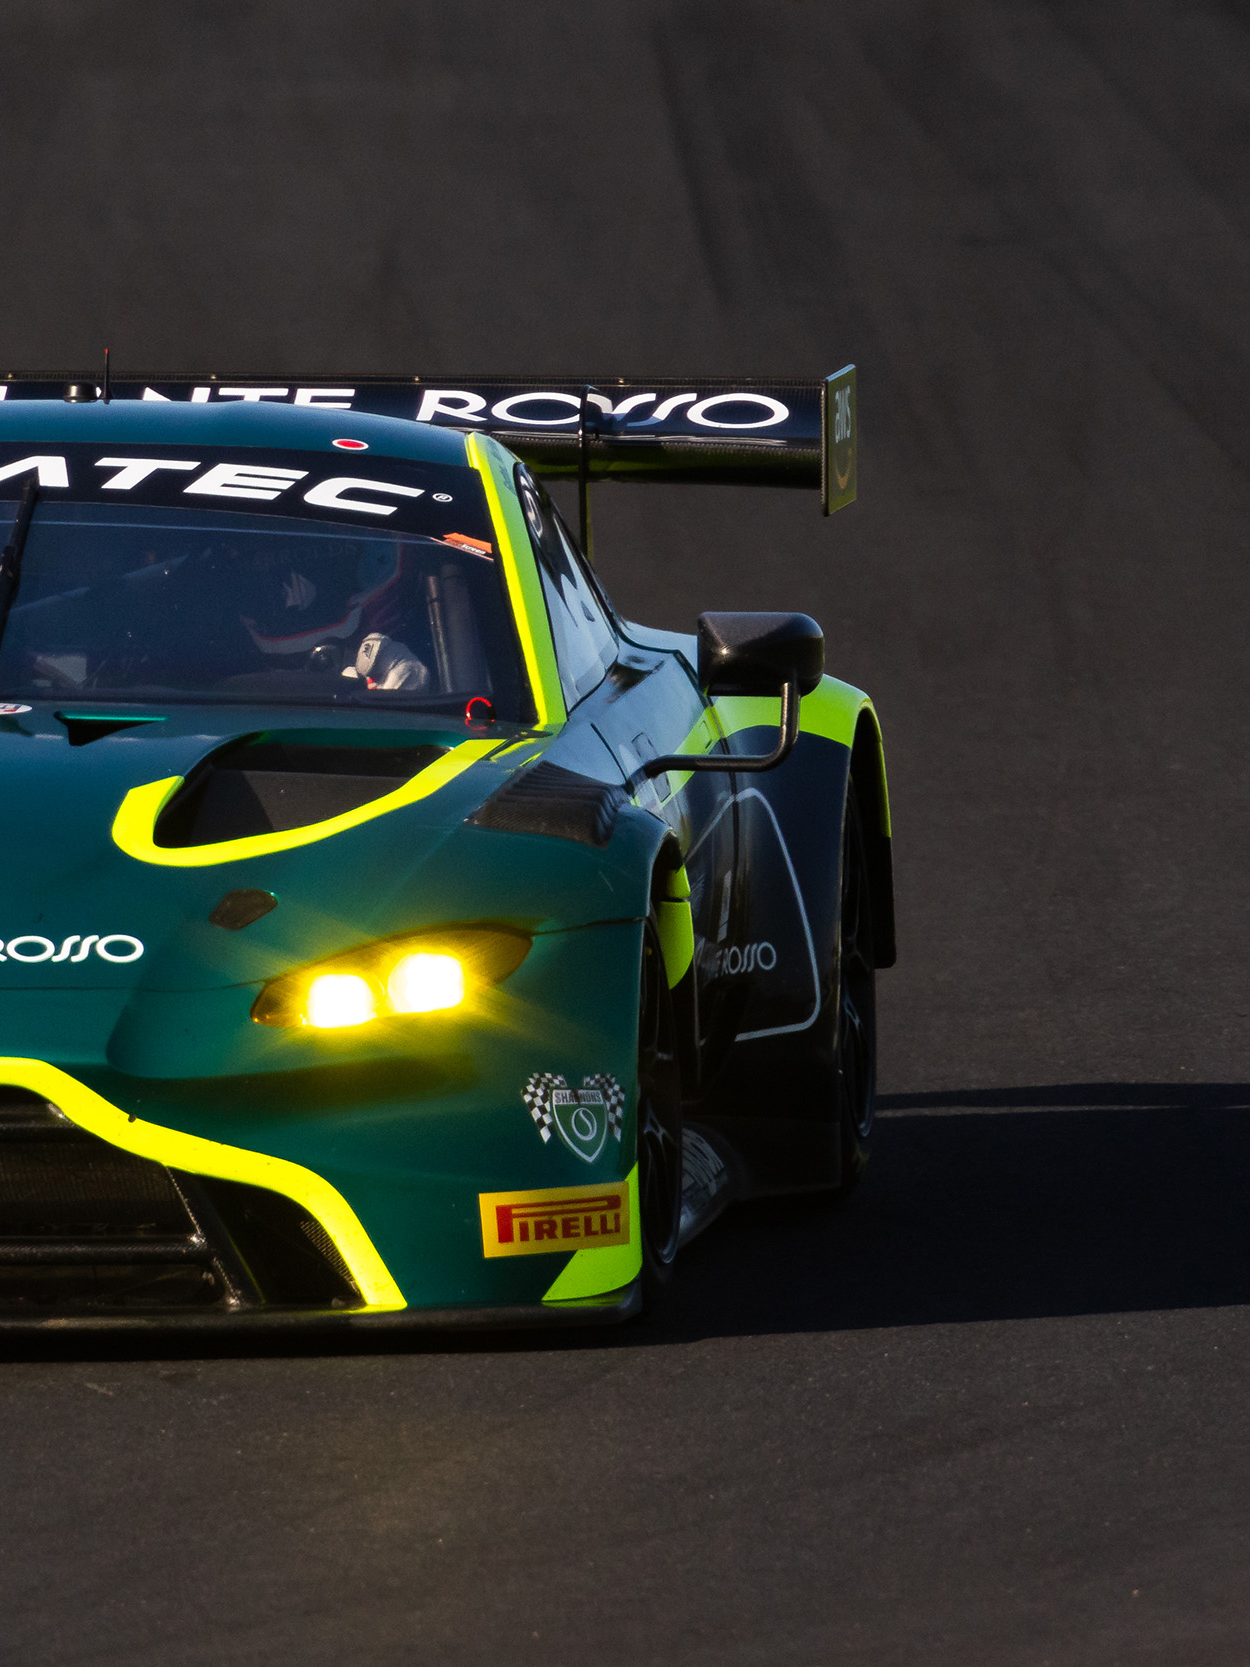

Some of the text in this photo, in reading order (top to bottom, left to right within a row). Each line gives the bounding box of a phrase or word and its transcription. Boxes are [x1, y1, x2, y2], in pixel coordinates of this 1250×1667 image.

[415, 389, 790, 430] ROSSO
[554, 1091, 602, 1105] SHANONS
[495, 1194, 622, 1244] PIRELLI
